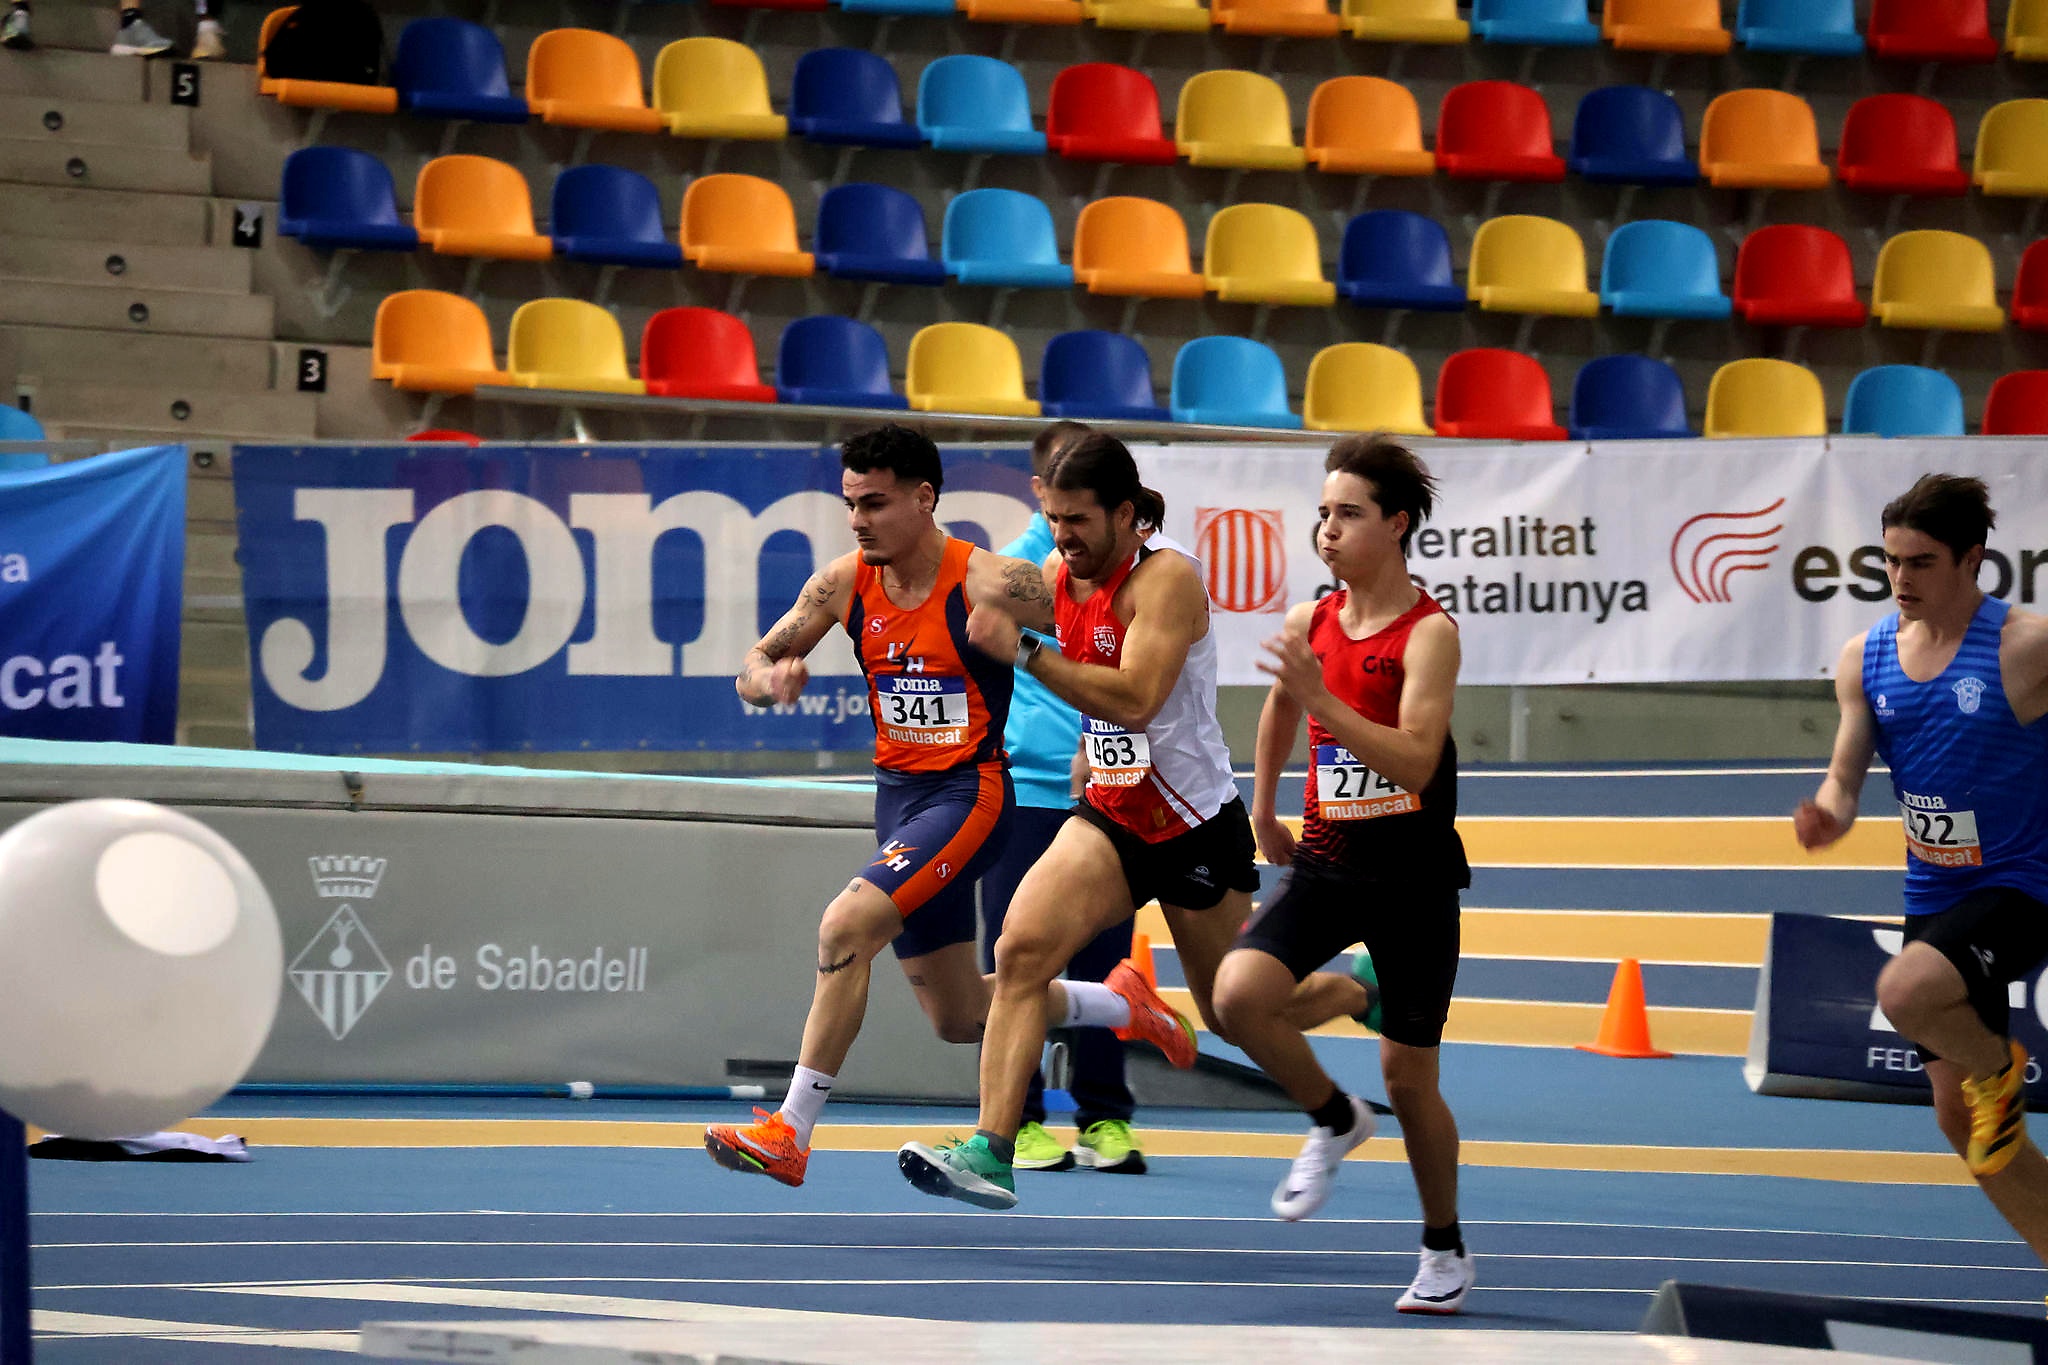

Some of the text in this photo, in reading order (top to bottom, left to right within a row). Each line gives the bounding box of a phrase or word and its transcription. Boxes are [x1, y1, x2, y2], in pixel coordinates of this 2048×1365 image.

[177, 73, 193, 97] 5
[304, 358, 320, 382] 3
[1312, 515, 1597, 559] eralitat
[870, 618, 883, 633] S
[891, 695, 951, 725] 341
[888, 728, 961, 744] mutuacat
[1094, 736, 1136, 767] 463
[1333, 767, 1396, 798] 274
[1325, 796, 1414, 819] mutuacat
[405, 943, 648, 992] de Sabadell
